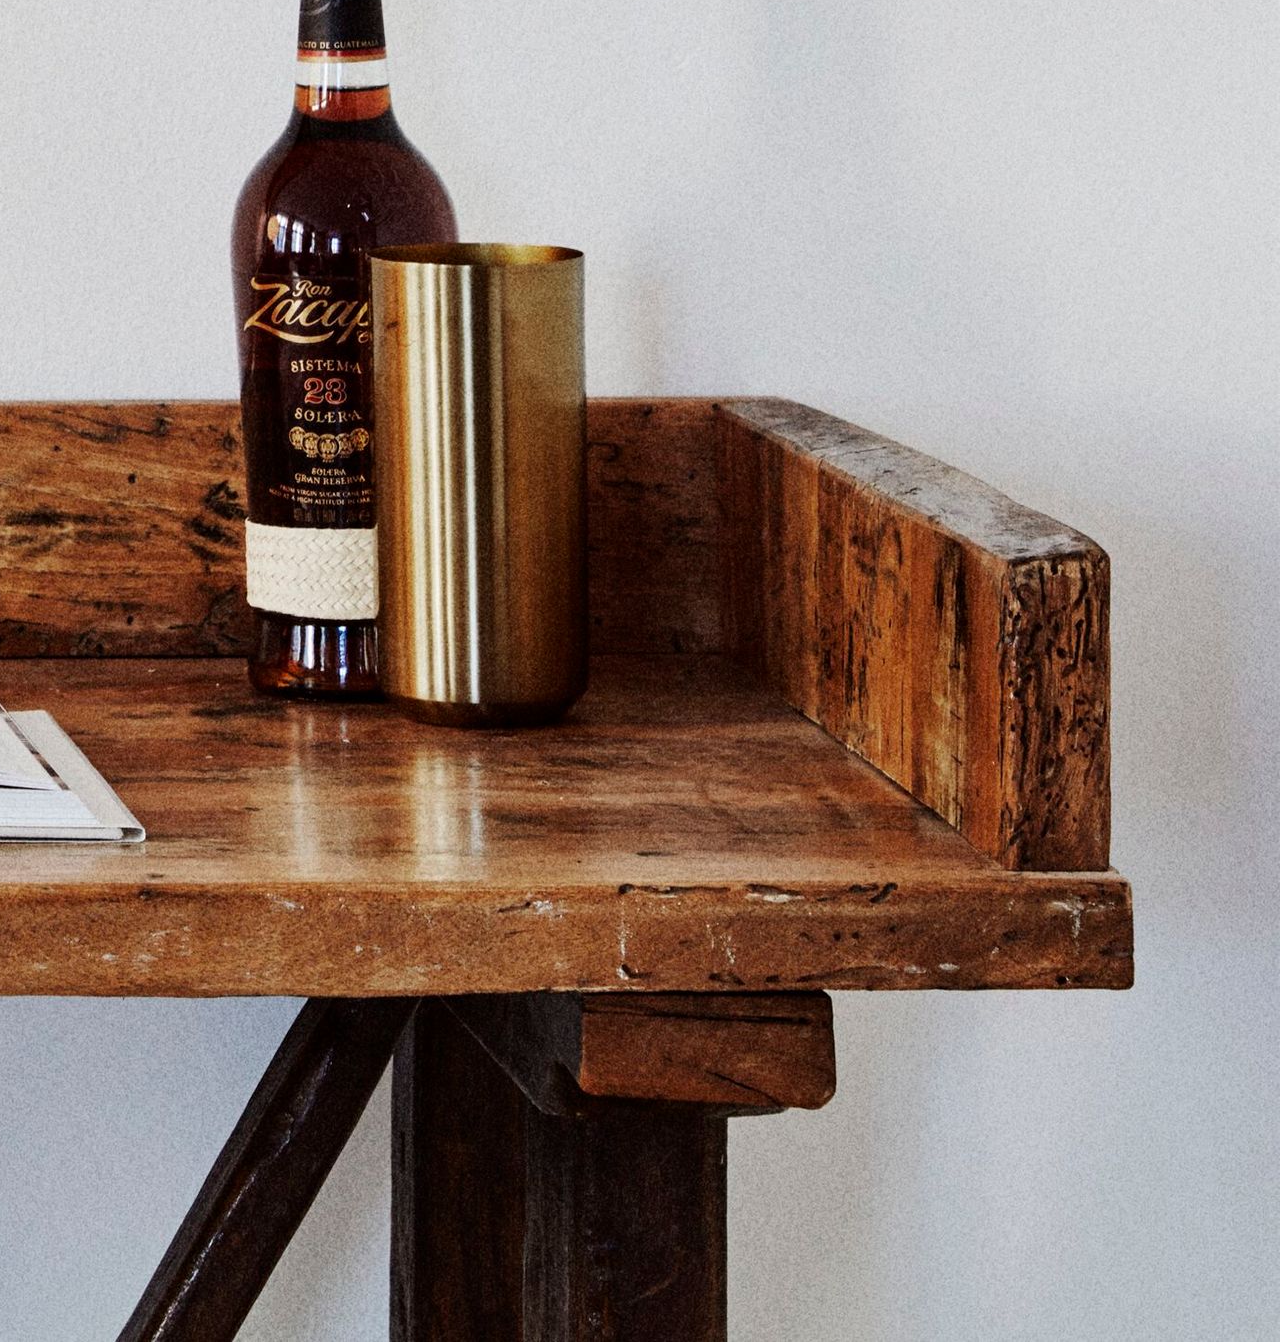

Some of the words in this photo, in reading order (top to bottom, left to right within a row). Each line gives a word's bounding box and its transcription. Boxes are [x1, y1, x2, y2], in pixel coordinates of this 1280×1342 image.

[334, 41, 379, 49] GUATEMALA
[292, 280, 332, 298] Ron
[244, 277, 368, 345] Zacap
[303, 377, 347, 405] 23
[311, 467, 346, 476] SOLERA
[294, 473, 320, 485] GRAN
[323, 474, 366, 486] RESERVA
[297, 489, 317, 497] VIRGIN
[314, 498, 345, 506] ALTITUDE
